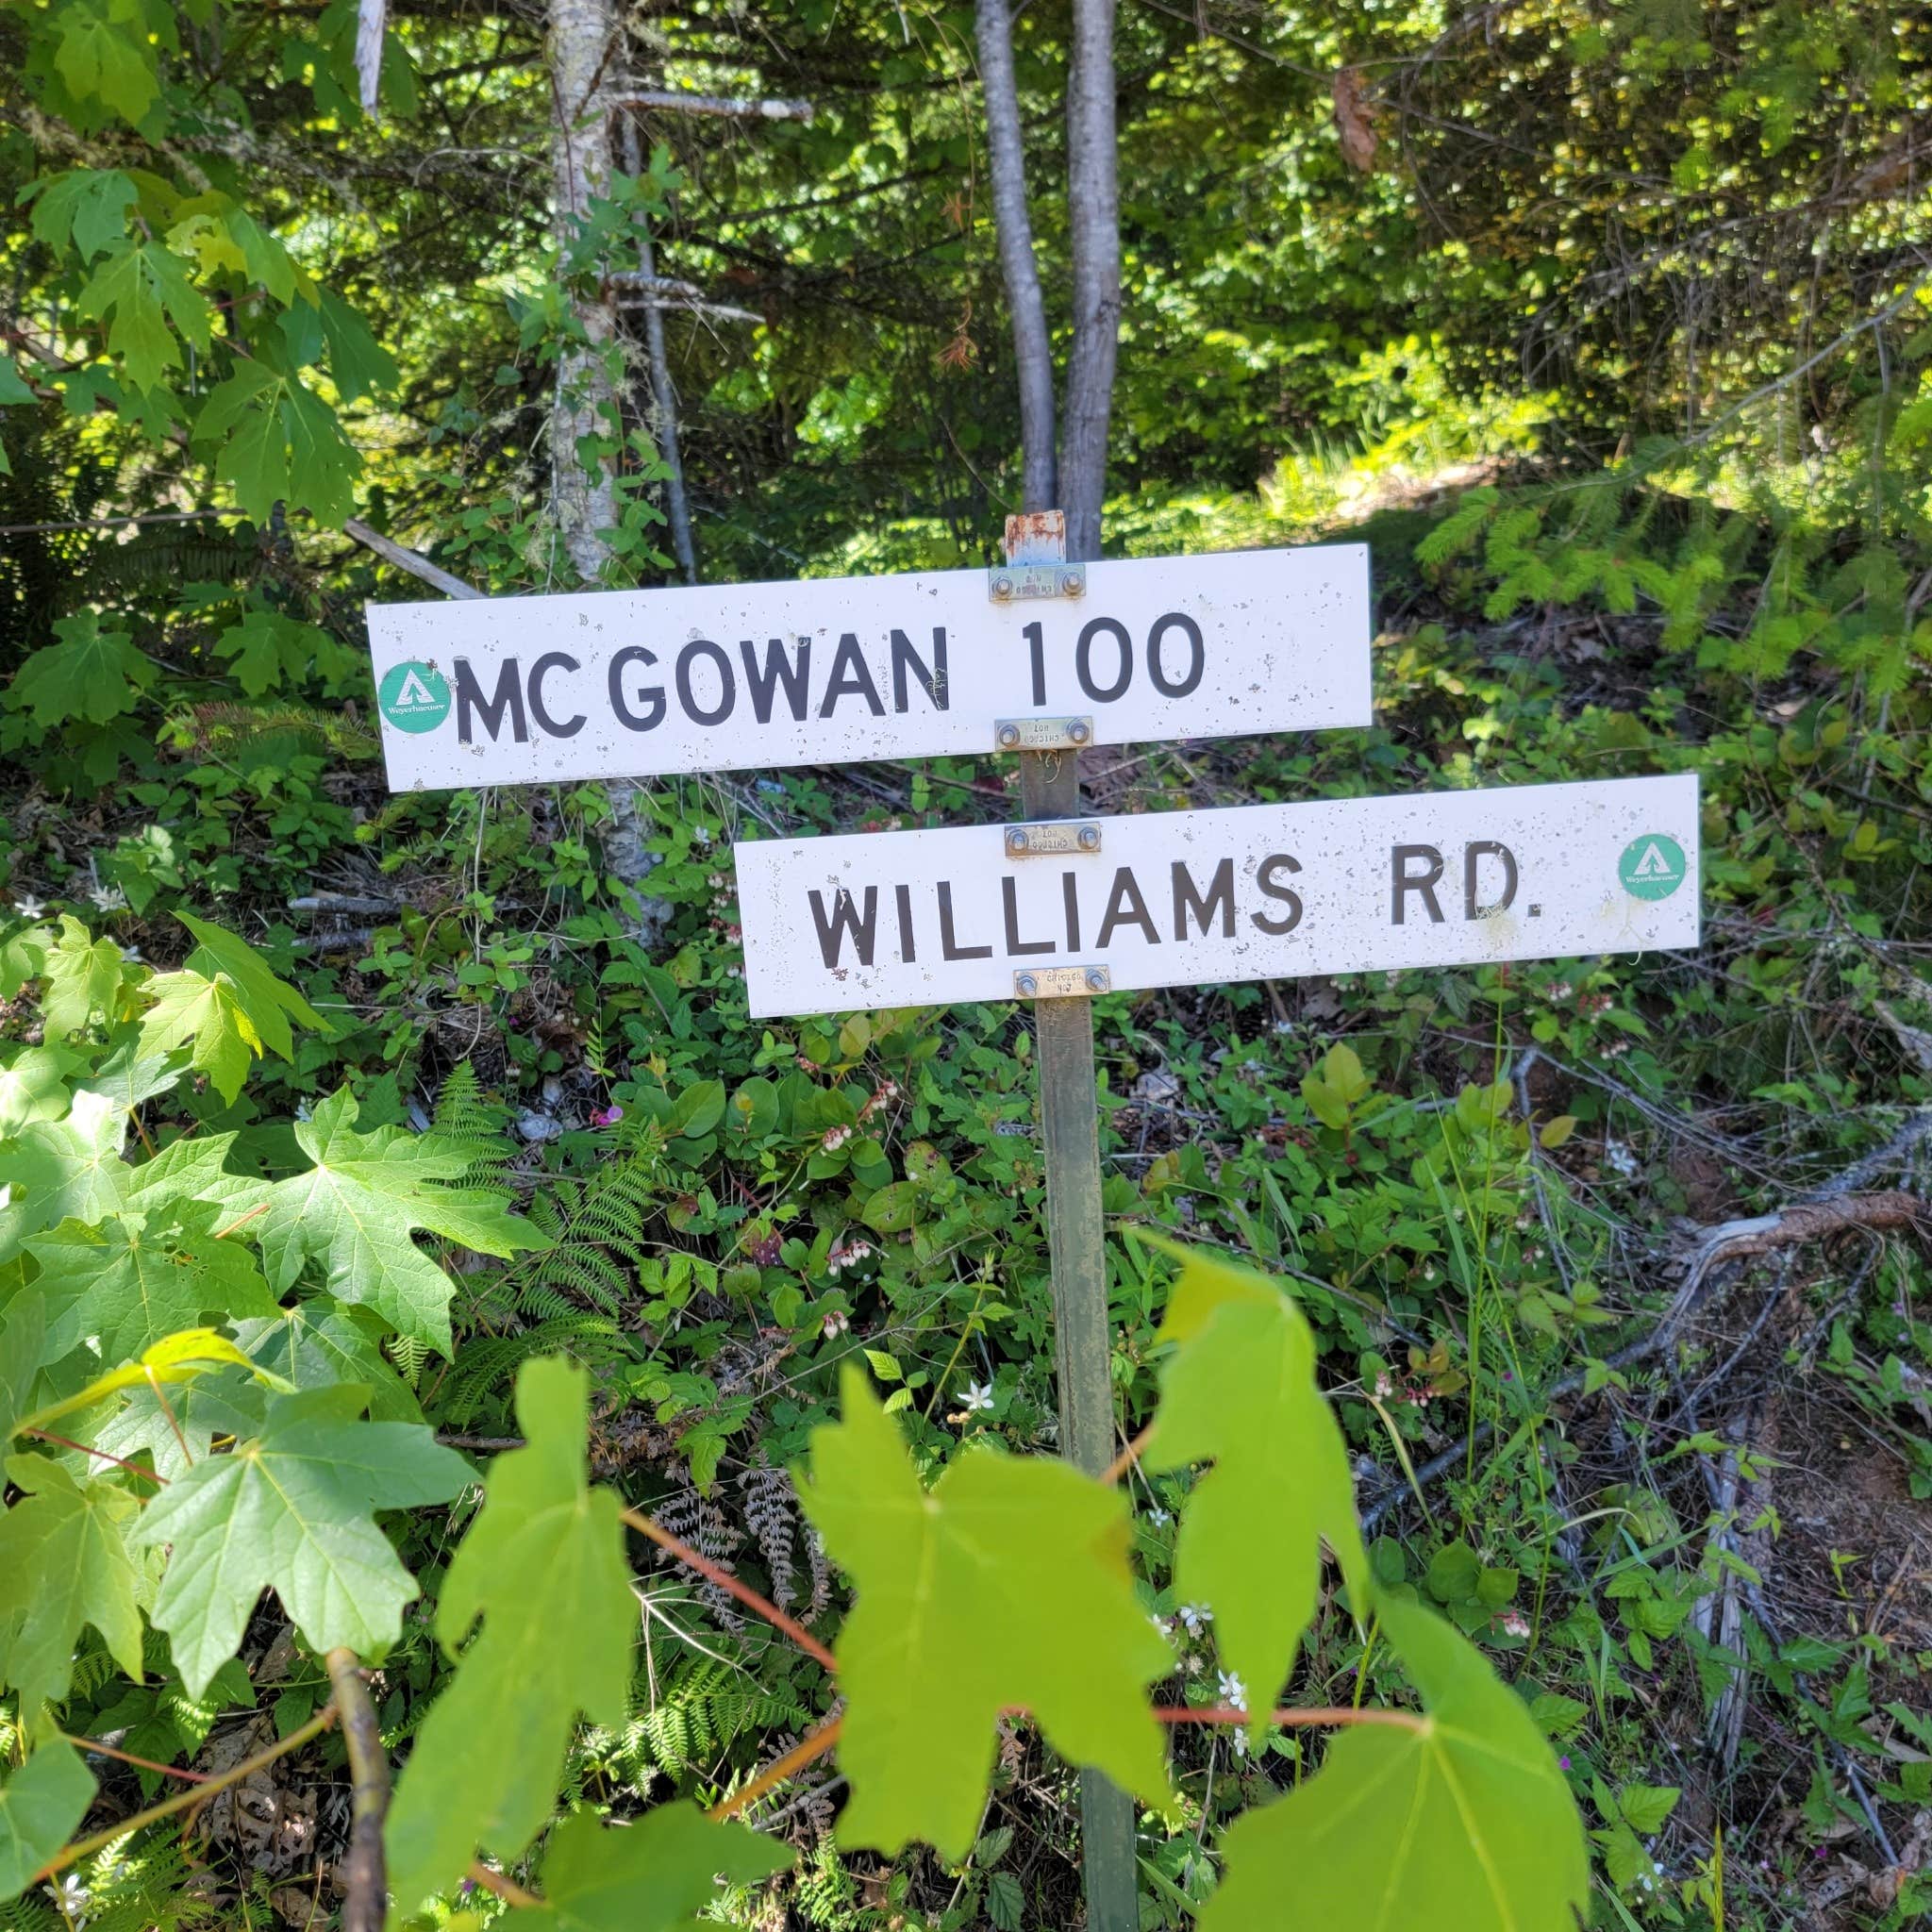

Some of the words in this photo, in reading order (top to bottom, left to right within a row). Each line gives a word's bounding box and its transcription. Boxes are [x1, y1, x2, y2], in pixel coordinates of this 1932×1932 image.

[1022, 611, 1205, 707] 100
[808, 853, 1304, 970] WILLIAMS
[1391, 840, 1542, 925] RD.
